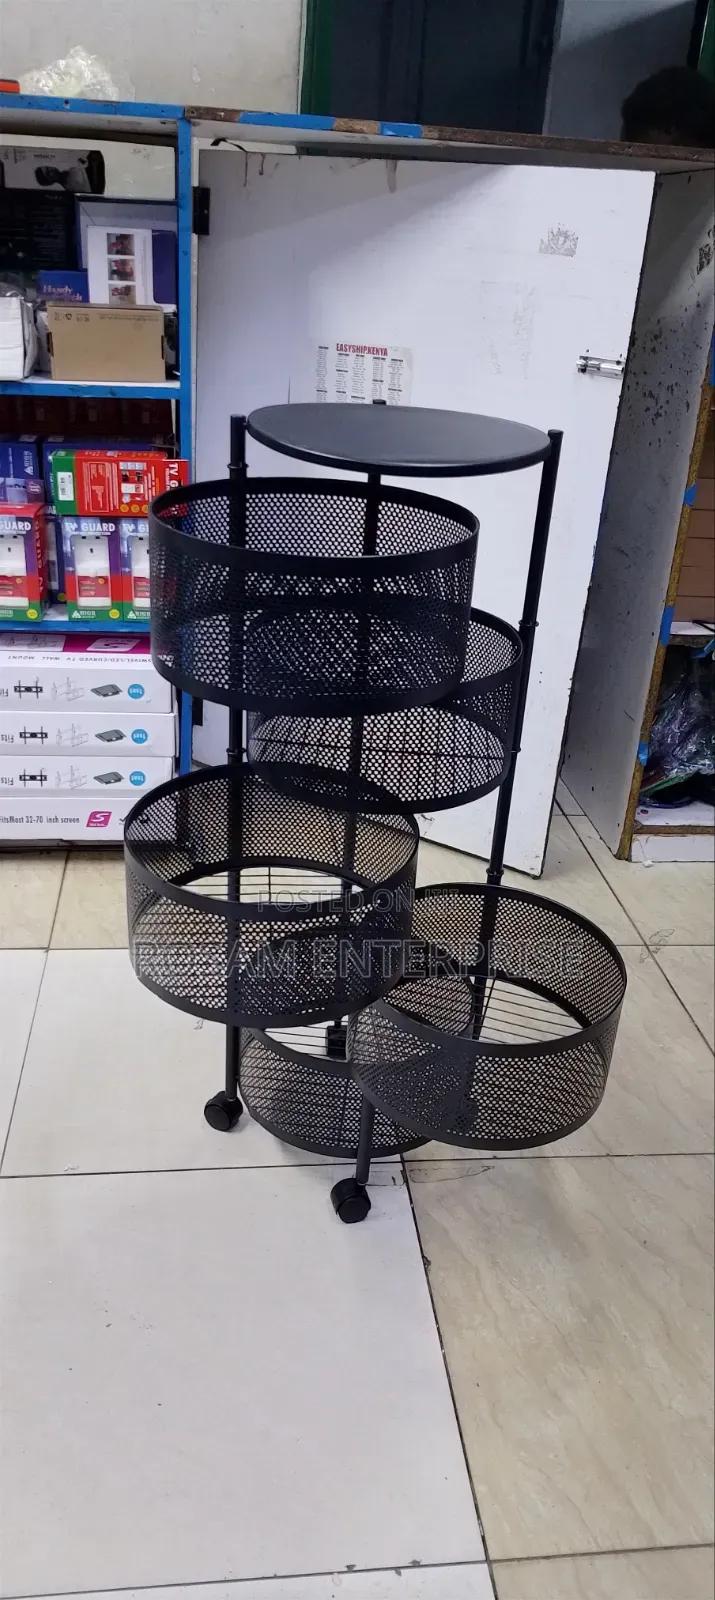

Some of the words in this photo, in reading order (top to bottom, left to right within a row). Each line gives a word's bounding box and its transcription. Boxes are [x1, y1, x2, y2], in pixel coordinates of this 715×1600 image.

[336, 343, 388, 356] EASYSHIP.KENYA
[169, 462, 178, 475] TV
[169, 480, 178, 490] G
[80, 522, 115, 532] GUARD
[1, 734, 14, 743] Fits
[1, 777, 14, 786] Fits
[25, 815, 44, 824] 32-70
[46, 815, 60, 824] inch
